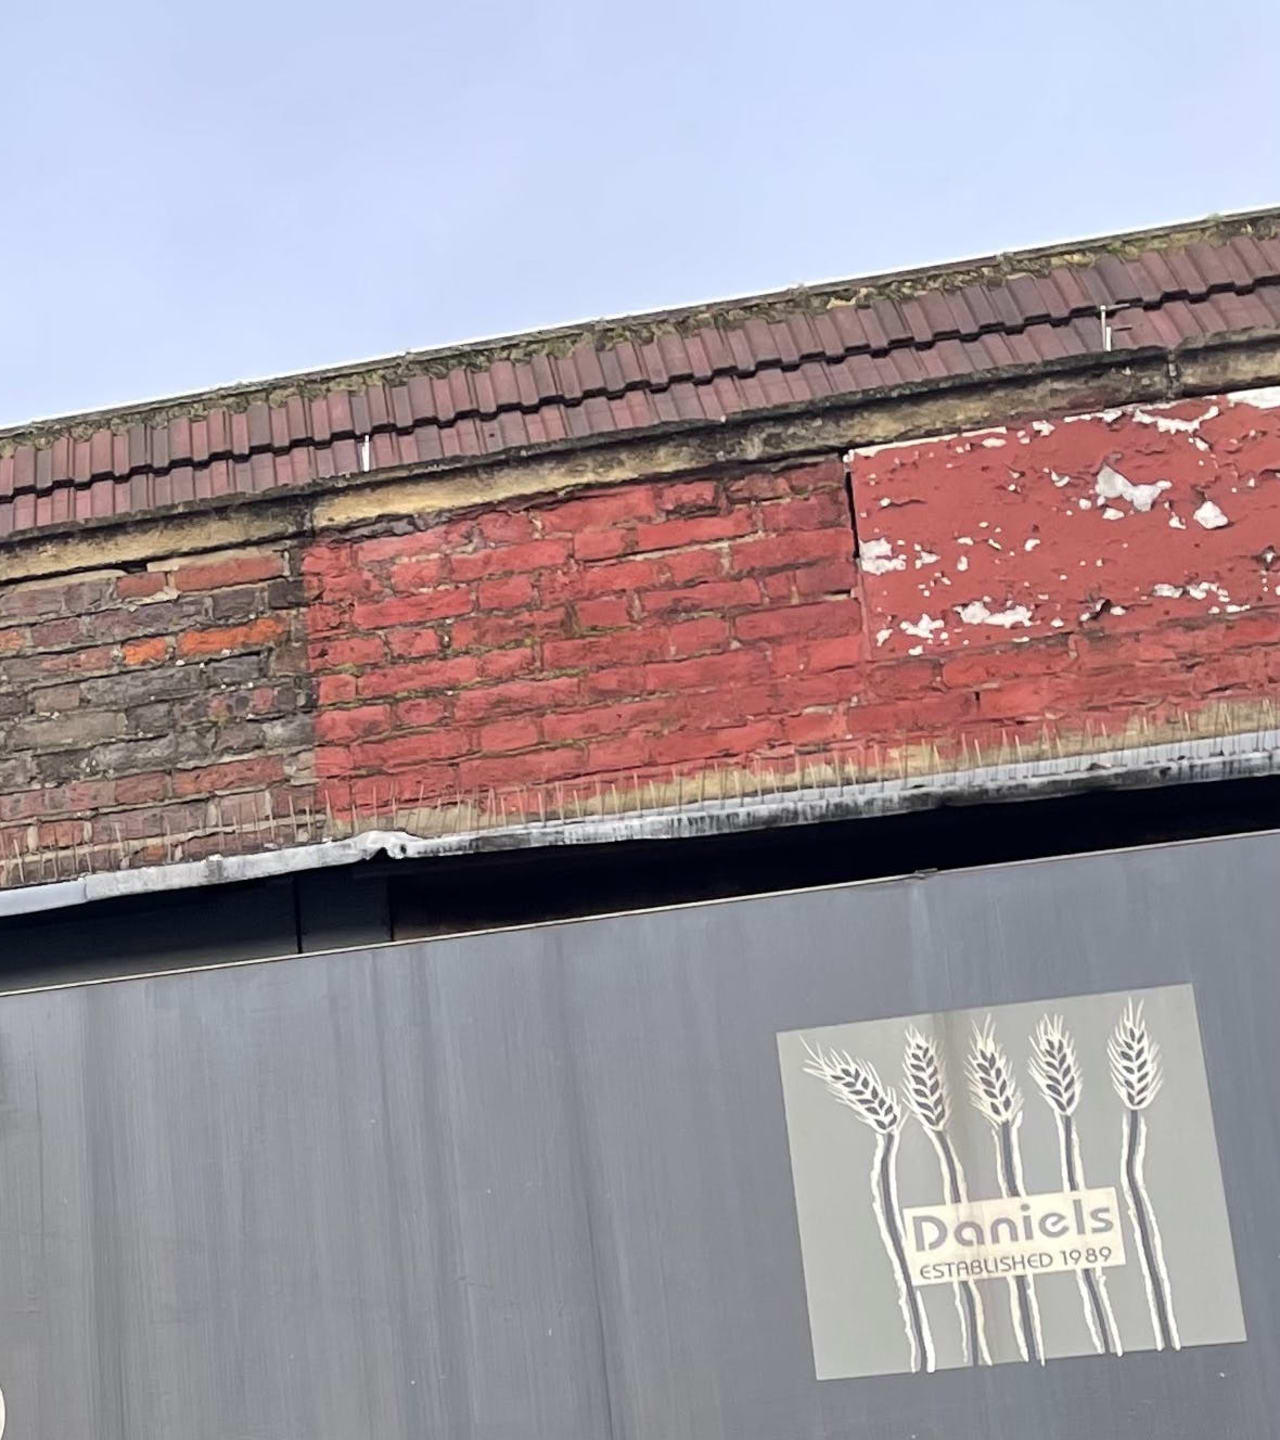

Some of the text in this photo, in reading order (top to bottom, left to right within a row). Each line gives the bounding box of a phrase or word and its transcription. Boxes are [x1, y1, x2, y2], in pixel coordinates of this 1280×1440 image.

[912, 1198, 1114, 1252] Daniels
[919, 1246, 1112, 1280] ESTABLISHED 1989
